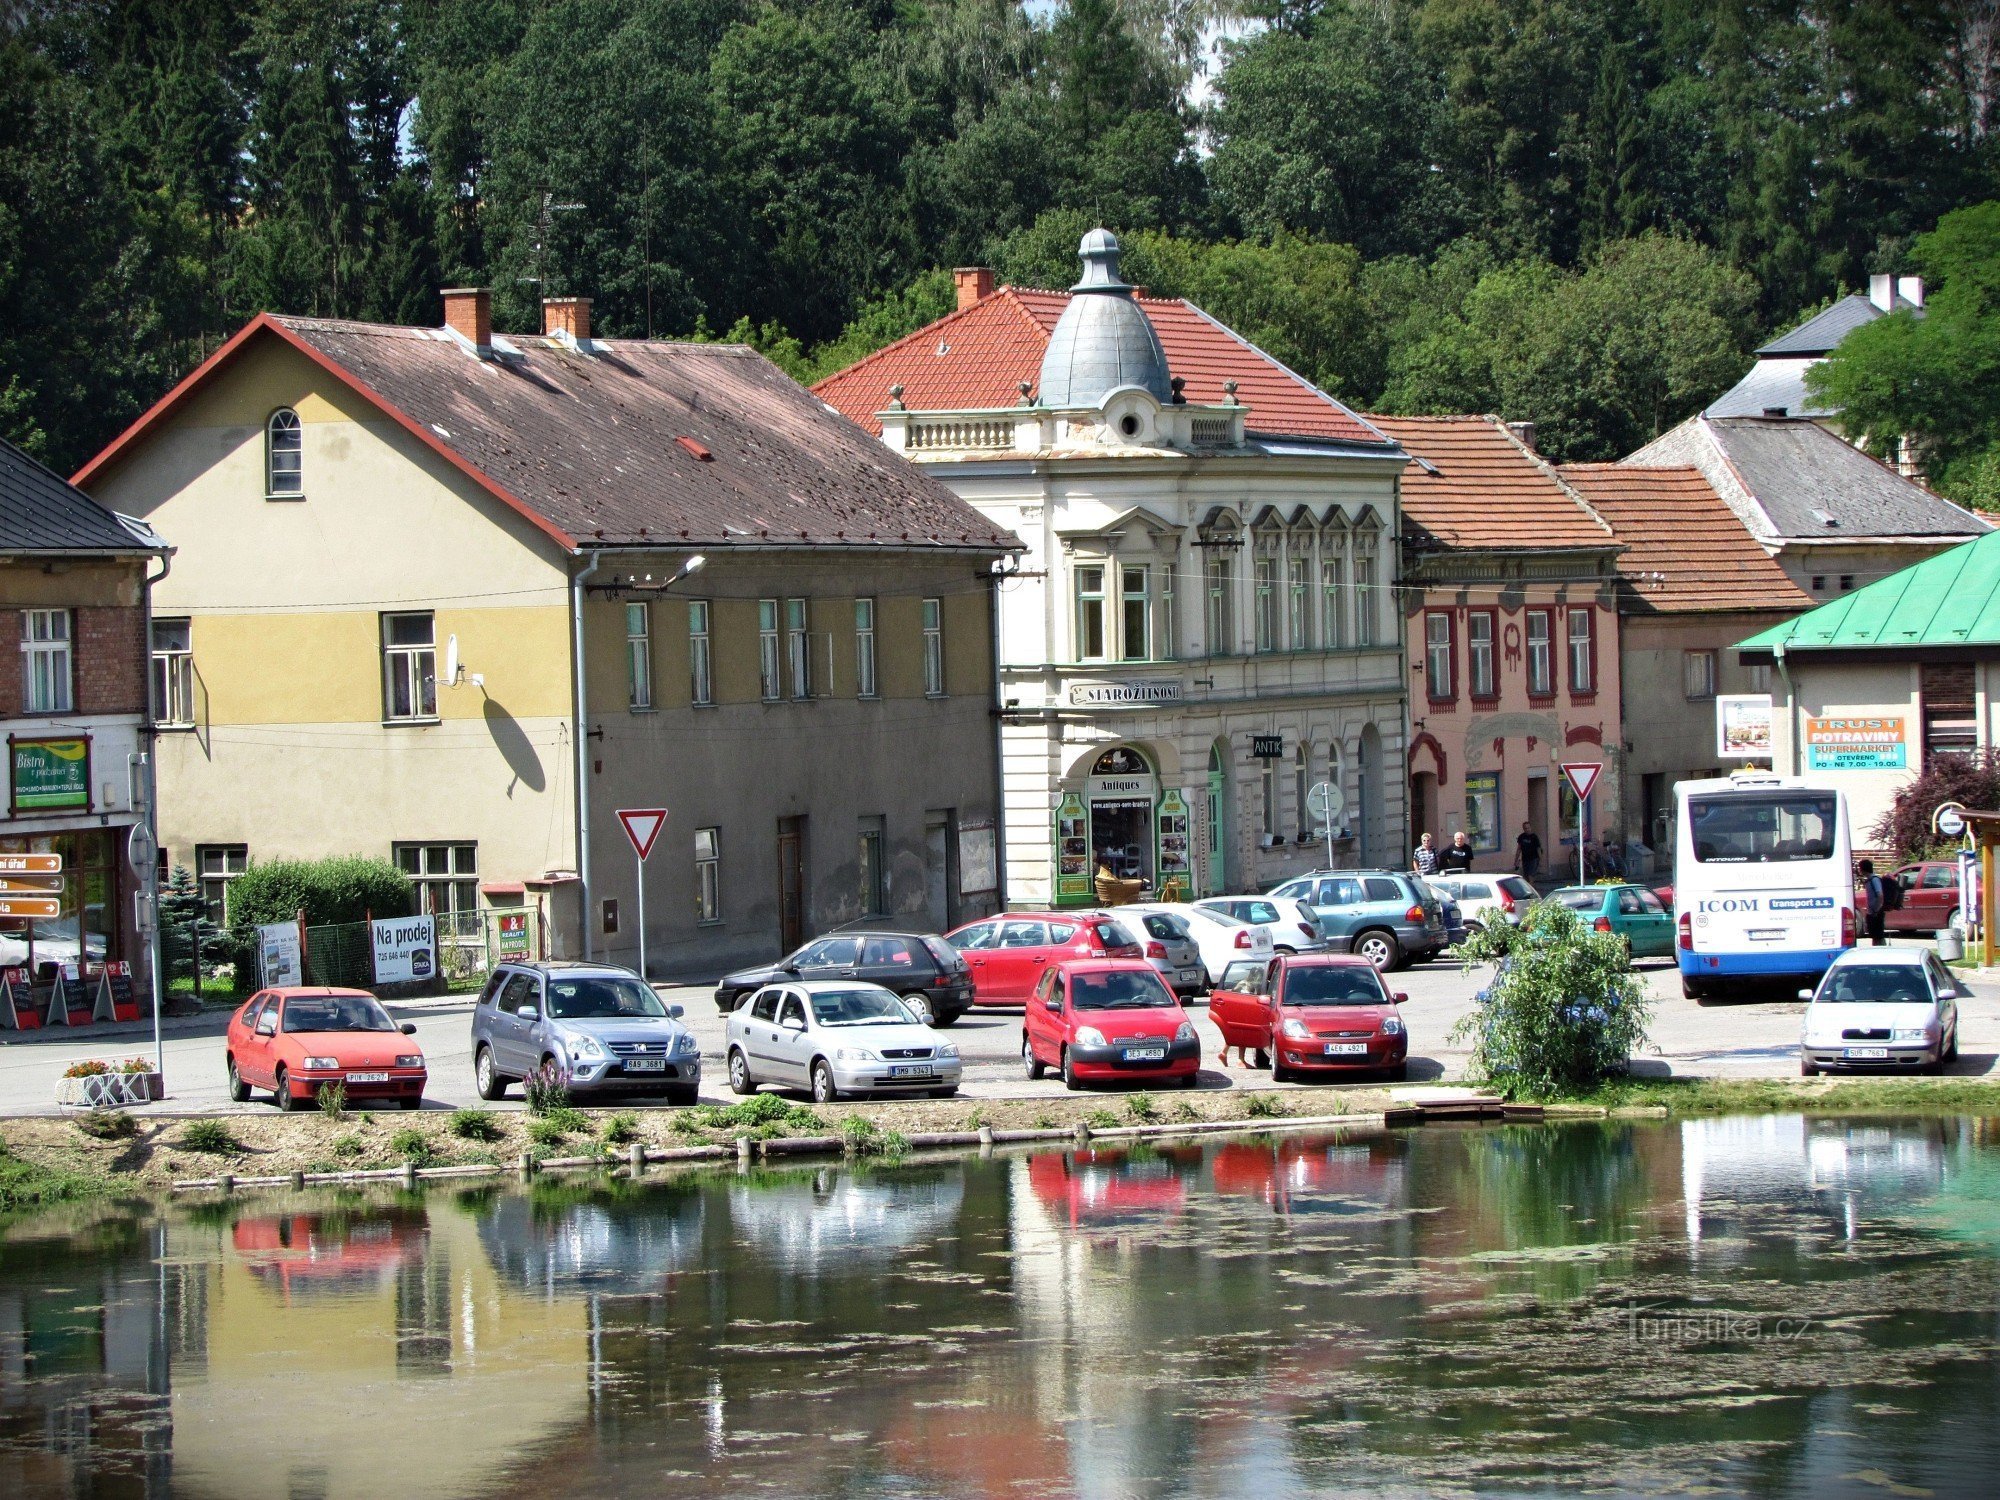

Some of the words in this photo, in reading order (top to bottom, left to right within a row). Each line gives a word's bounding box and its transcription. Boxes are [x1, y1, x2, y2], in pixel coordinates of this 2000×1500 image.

[1088, 684, 1179, 701] STAROŽITNOSTI
[1812, 719, 1898, 729] TRUST
[1811, 731, 1899, 742] POTRAVINY
[1255, 740, 1281, 753] ANTIK
[1815, 744, 1896, 753] SUPERMARKET
[17, 753, 45, 768] Bistro
[1101, 781, 1140, 791] Antiques
[8, 858, 26, 869] úřad
[1698, 899, 1760, 912] ICOM
[1772, 899, 1813, 908] transport
[1815, 898, 1832, 906] a.s.
[376, 926, 392, 945] Na
[396, 921, 431, 947] prodej
[399, 950, 409, 959] 440
